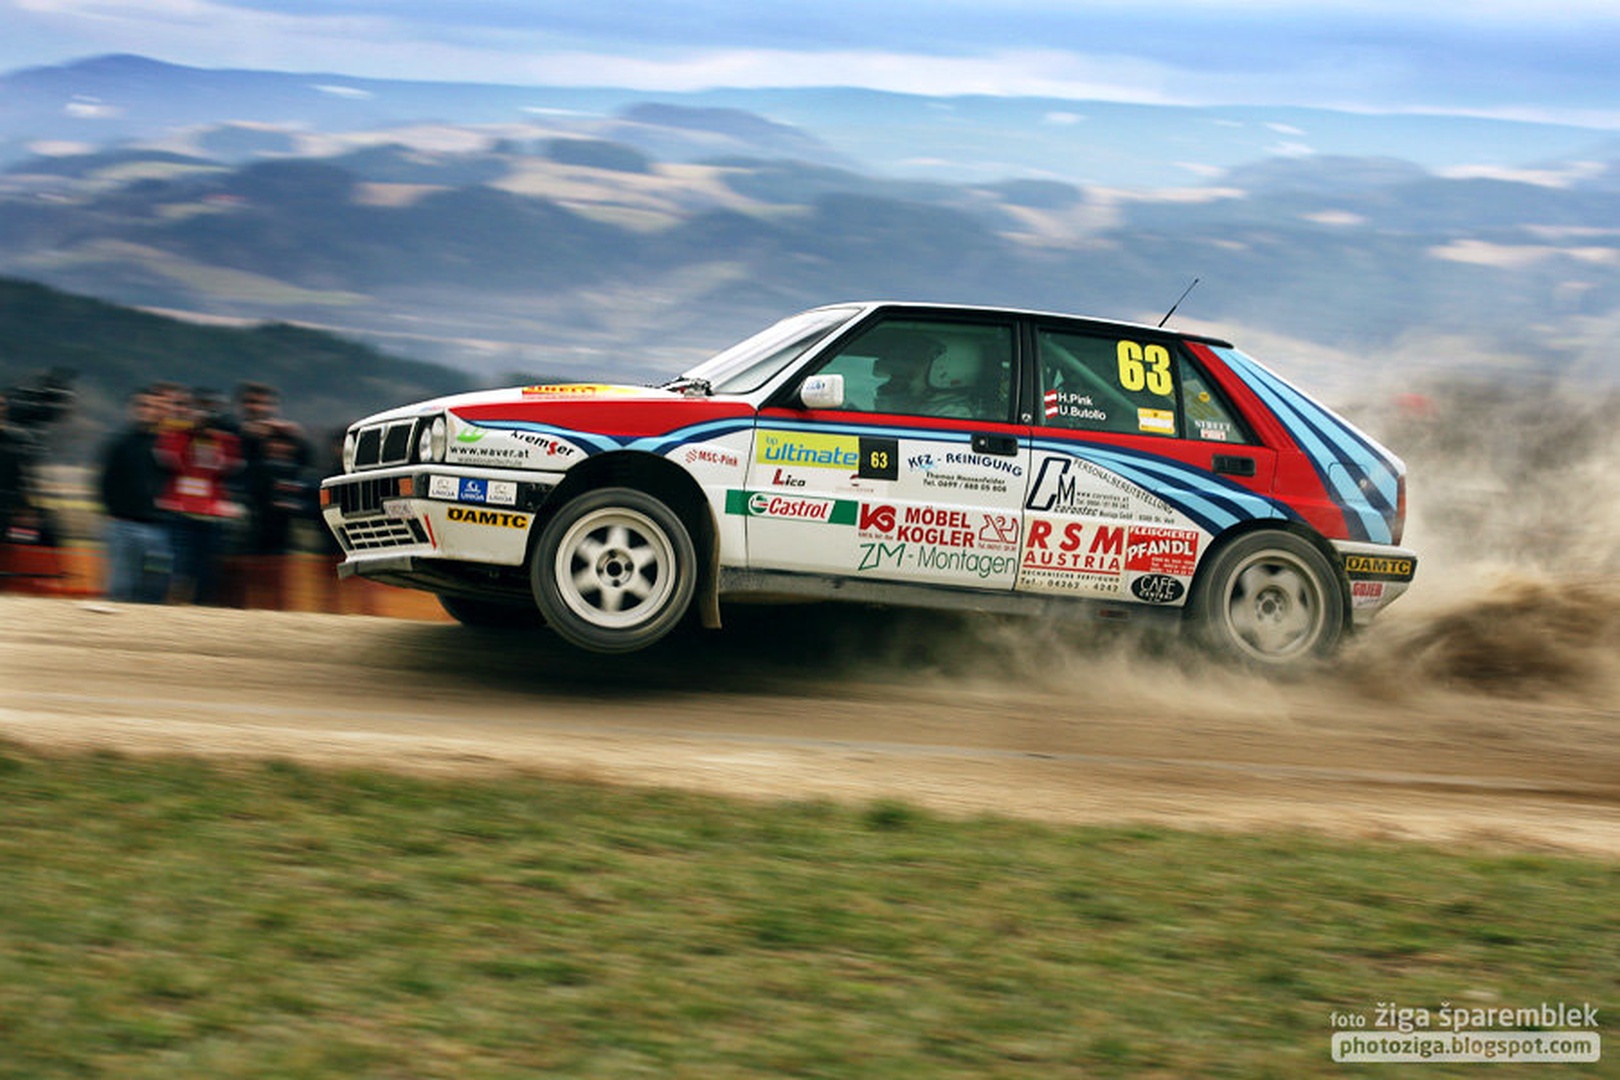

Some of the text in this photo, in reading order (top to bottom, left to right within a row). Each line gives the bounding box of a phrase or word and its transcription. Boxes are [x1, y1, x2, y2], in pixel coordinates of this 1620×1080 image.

[1117, 340, 1174, 396] 63
[449, 445, 530, 459] www.waver.at
[765, 443, 859, 466] ultimate
[870, 451, 888, 469] 63
[946, 453, 1022, 477] REINIGUNG
[769, 497, 829, 519] Castrol
[905, 505, 971, 529] MÖBEL
[897, 525, 975, 548] KOGLER
[1026, 520, 1124, 556] RSM
[858, 542, 906, 571] ZM
[917, 546, 1016, 578] Montagen
[1024, 550, 1120, 570] AUSTRIA
[1127, 540, 1194, 562] PFANDL
